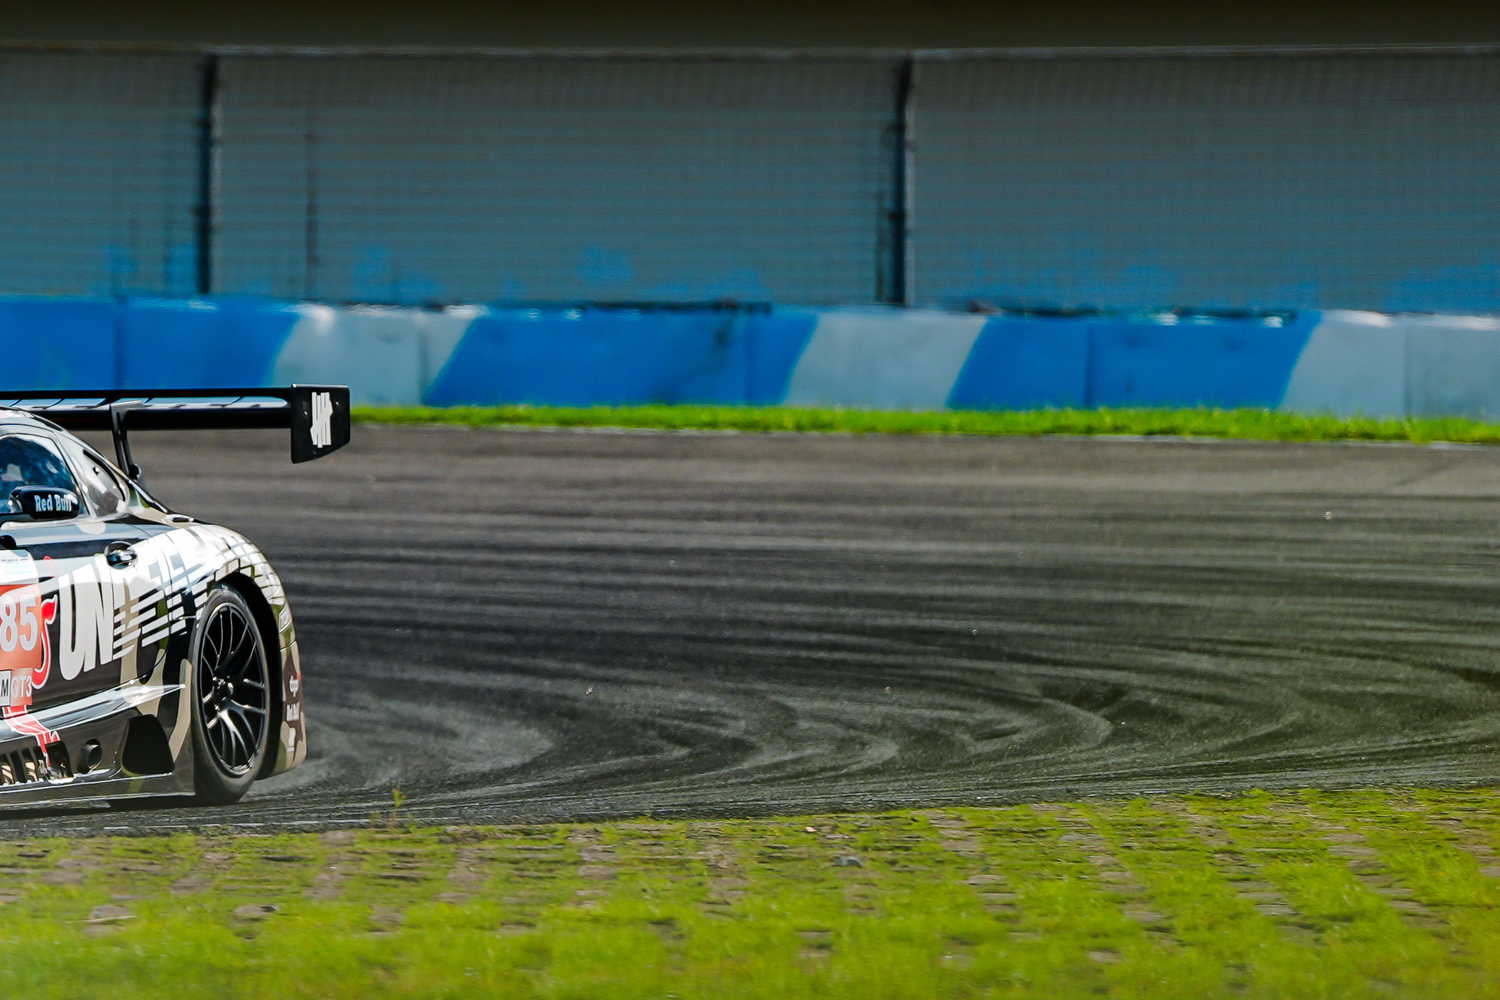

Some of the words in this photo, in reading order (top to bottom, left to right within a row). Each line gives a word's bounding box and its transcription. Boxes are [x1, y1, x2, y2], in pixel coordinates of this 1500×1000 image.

[34, 494, 53, 512] Red
[54, 494, 72, 512] Bull
[11, 675, 32, 698] GT3
